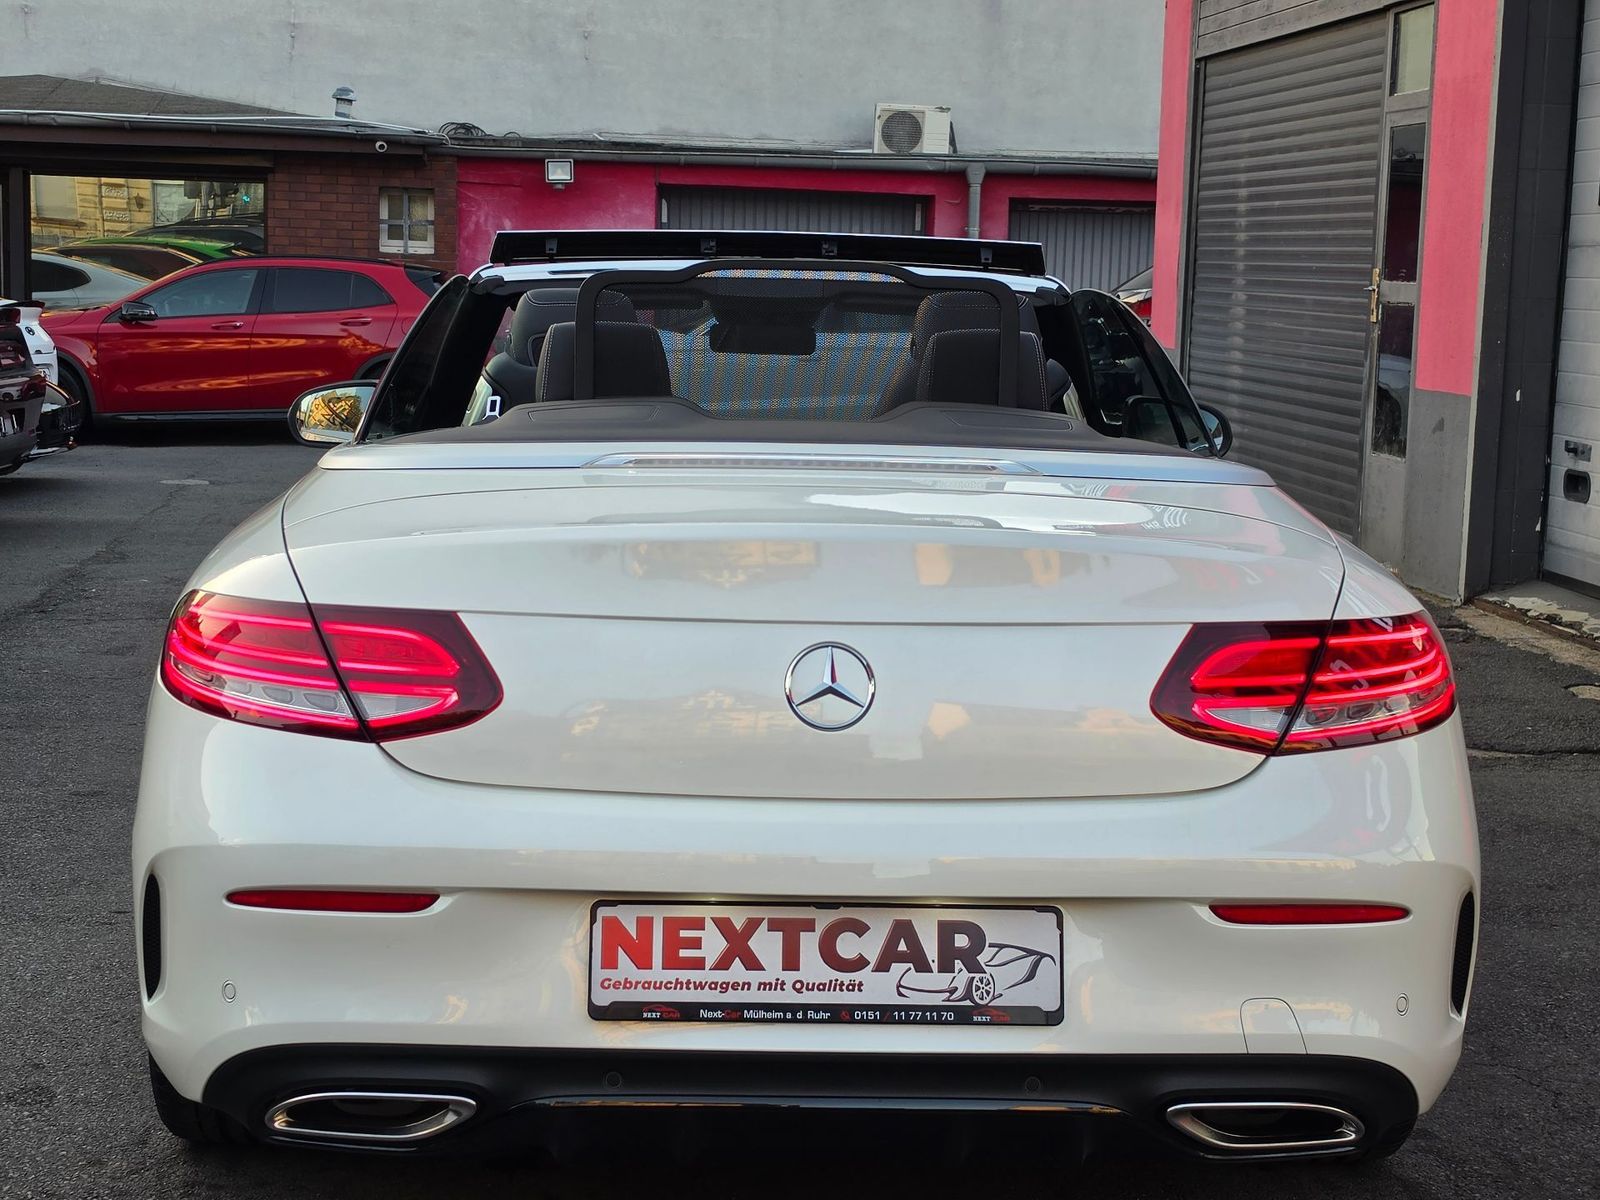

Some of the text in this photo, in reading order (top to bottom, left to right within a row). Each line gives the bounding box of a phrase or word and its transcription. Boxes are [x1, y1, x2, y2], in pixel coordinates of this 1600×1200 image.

[601, 915, 987, 974] NEXTCAR
[600, 977, 864, 994] Gebrauchtwagen mit Qualität
[699, 1009, 740, 1018] Next-Car
[743, 1009, 784, 1019] Mülheim
[807, 1010, 831, 1020] Ruhr
[854, 1011, 880, 1020] 0151
[893, 1011, 905, 1020] 11
[909, 1011, 922, 1020] 77
[925, 1011, 937, 1021] 11
[940, 1011, 954, 1021] 70
